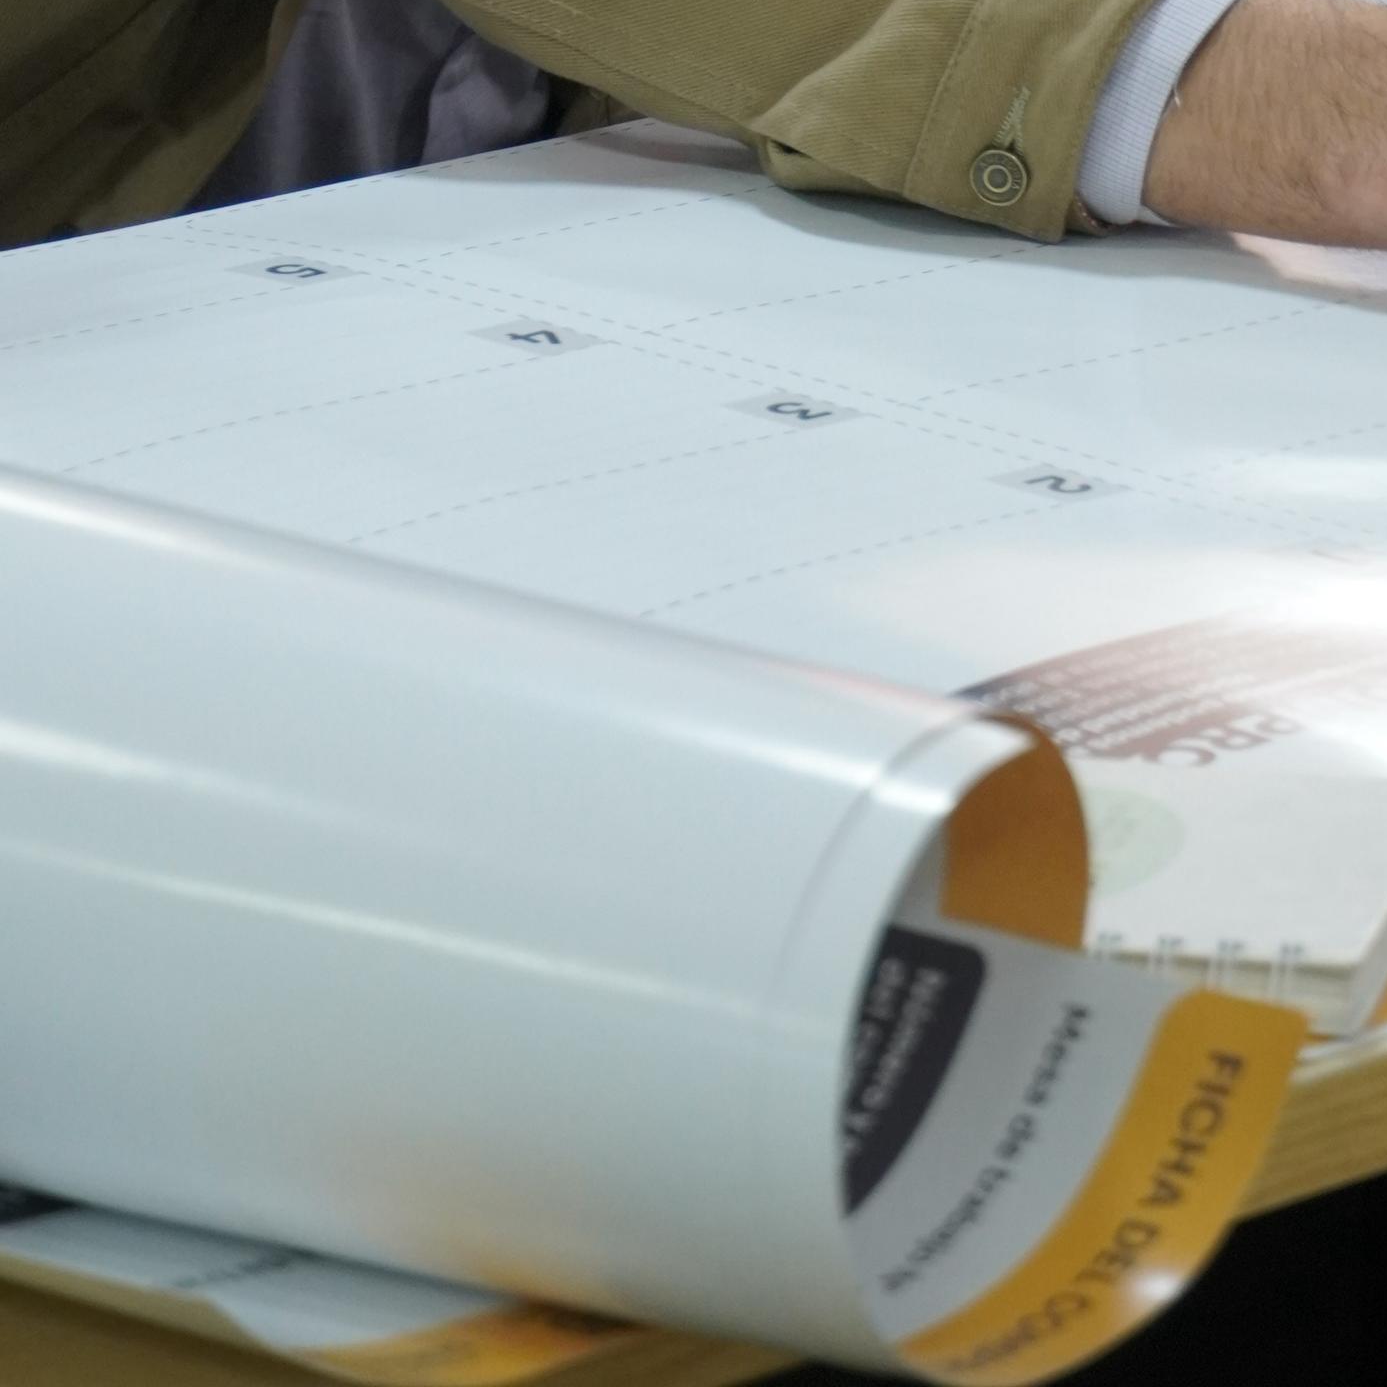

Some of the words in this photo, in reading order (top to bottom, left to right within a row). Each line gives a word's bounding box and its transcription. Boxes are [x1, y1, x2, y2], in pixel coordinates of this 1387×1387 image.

[265, 263, 328, 279] 5
[507, 330, 561, 345] 4
[766, 402, 833, 421] 3
[1026, 475, 1093, 494] 2
[1022, 1000, 1093, 1107] Mesa
[996, 1112, 1036, 1161] de
[1137, 1049, 1245, 1209] FICHA
[1075, 1217, 1164, 1285] DEL
